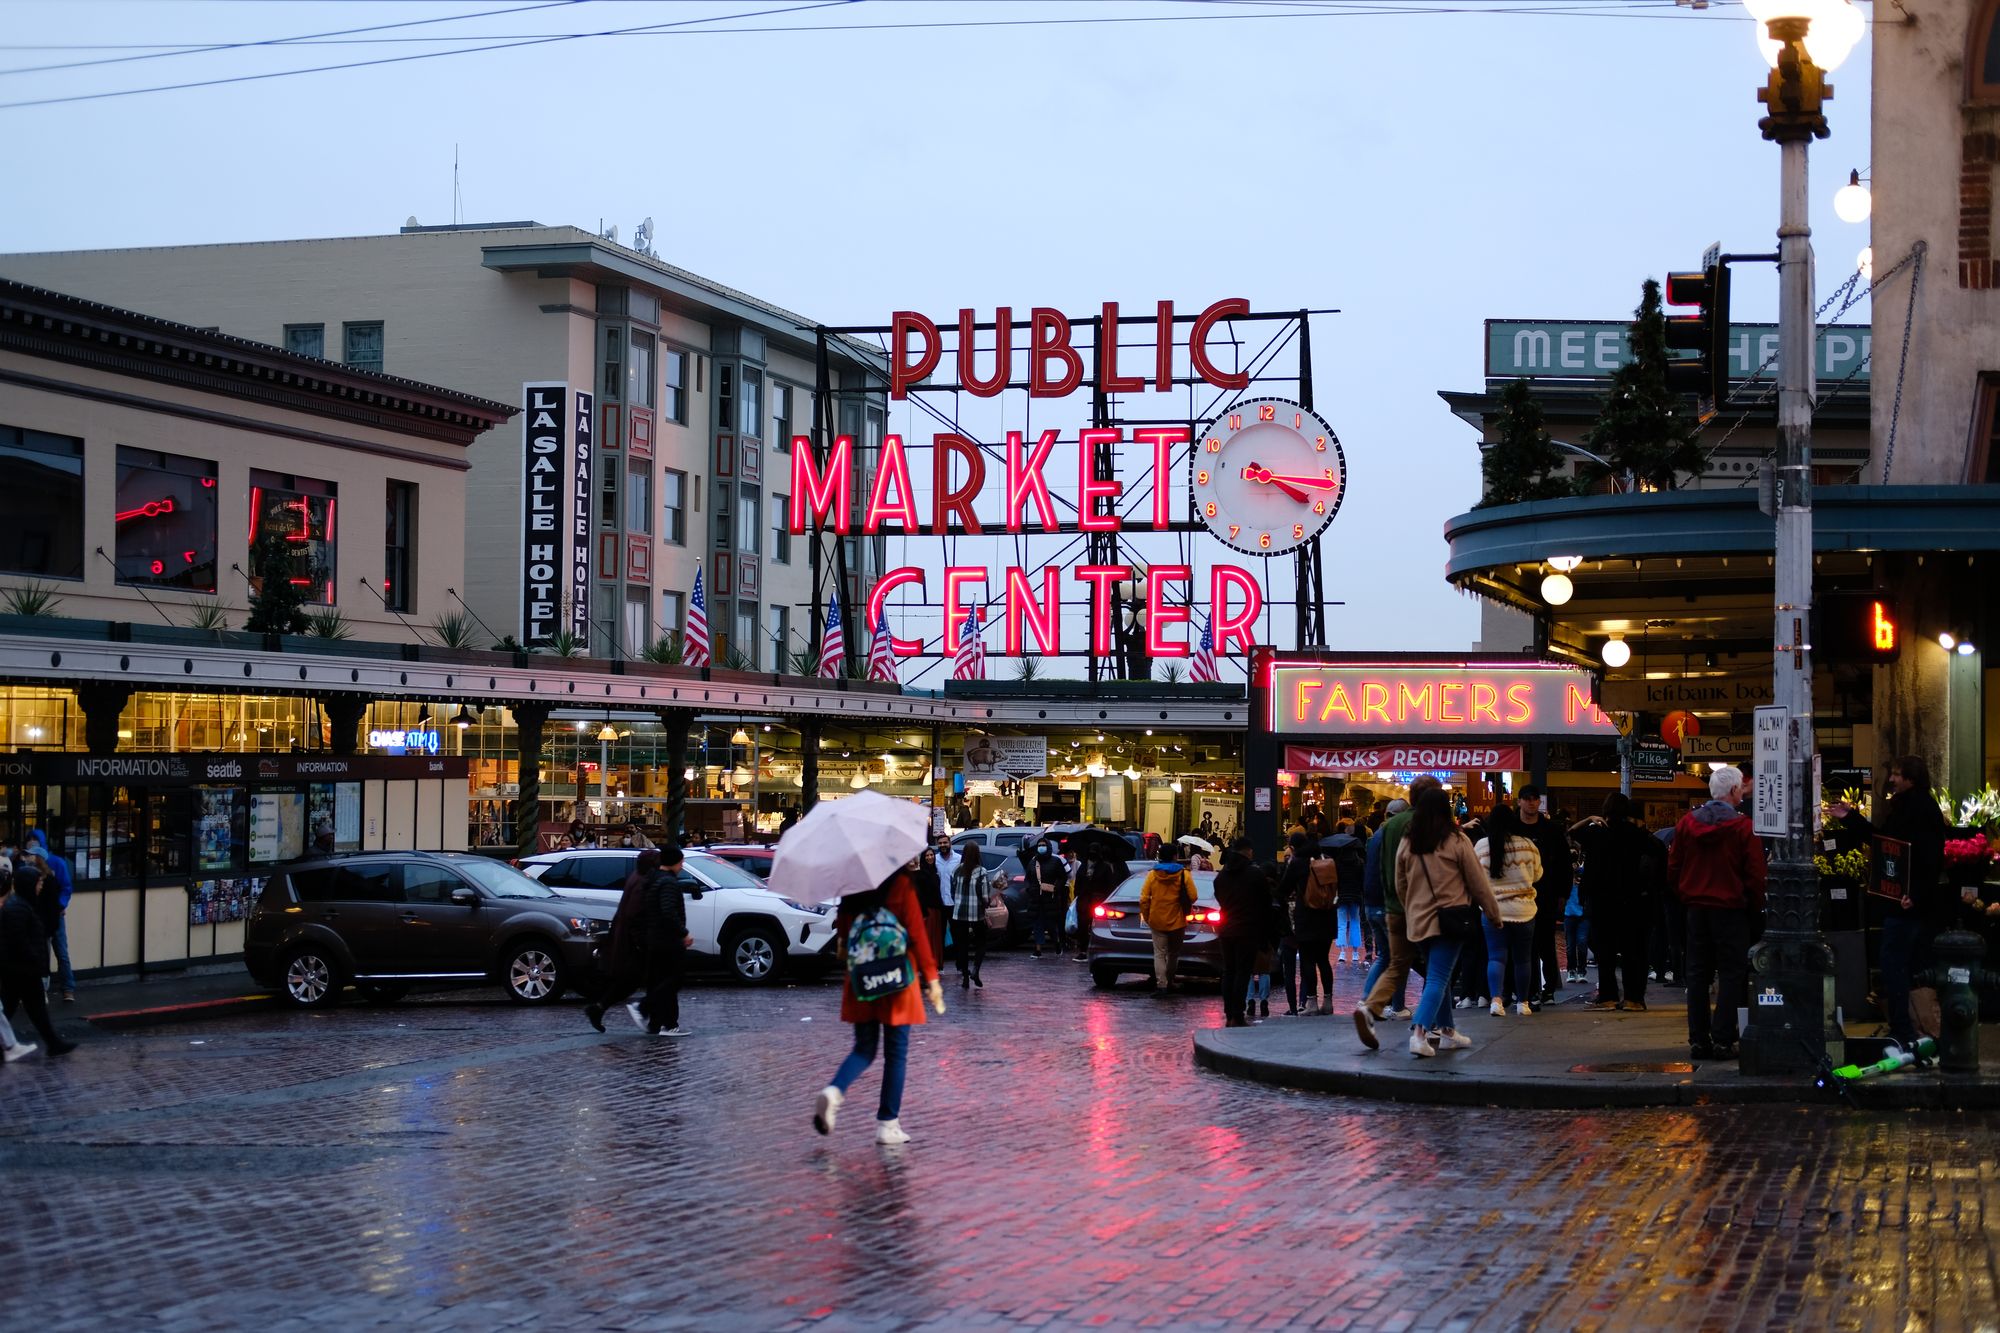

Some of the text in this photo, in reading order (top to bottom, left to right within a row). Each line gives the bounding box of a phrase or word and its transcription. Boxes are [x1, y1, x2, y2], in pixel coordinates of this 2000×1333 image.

[891, 298, 1250, 400] PUBLIC
[1514, 329, 1629, 369] MEE
[1826, 335, 1872, 373] P
[1260, 406, 1275, 421] 12
[1295, 413, 1301, 428] 1
[1229, 415, 1241, 430] 11
[1206, 439, 1220, 453] 10
[1316, 436, 1326, 451] 2
[790, 427, 1191, 536] MARKET
[1198, 471, 1209, 484] 9
[1205, 502, 1217, 517] 8
[1313, 501, 1325, 515] 4
[529, 392, 557, 640] LA SALLE HOTEL
[574, 397, 590, 640] LA SALLE HOTEL
[1229, 525, 1240, 539] 7
[1293, 525, 1303, 538] 5
[1260, 534, 1271, 548] 6
[867, 564, 1262, 658] CENTER
[1678, 684, 1728, 700] bank
[1736, 683, 1774, 699] boo
[1296, 680, 1532, 724] FARMERS
[1759, 718, 1770, 731] ALL
[369, 731, 428, 747] CHASE ATM
[997, 740, 1044, 749] YOUR CHANGE
[1687, 738, 1712, 754] The
[1763, 737, 1779, 751] WALK
[1309, 749, 1499, 768] MASKS REQUIRED
[1639, 752, 1661, 765] Pike
[77, 758, 169, 776] INFORMATION
[207, 760, 242, 778] seattle
[297, 762, 348, 773] INFORMATION
[1482, 788, 1514, 801] LOER
